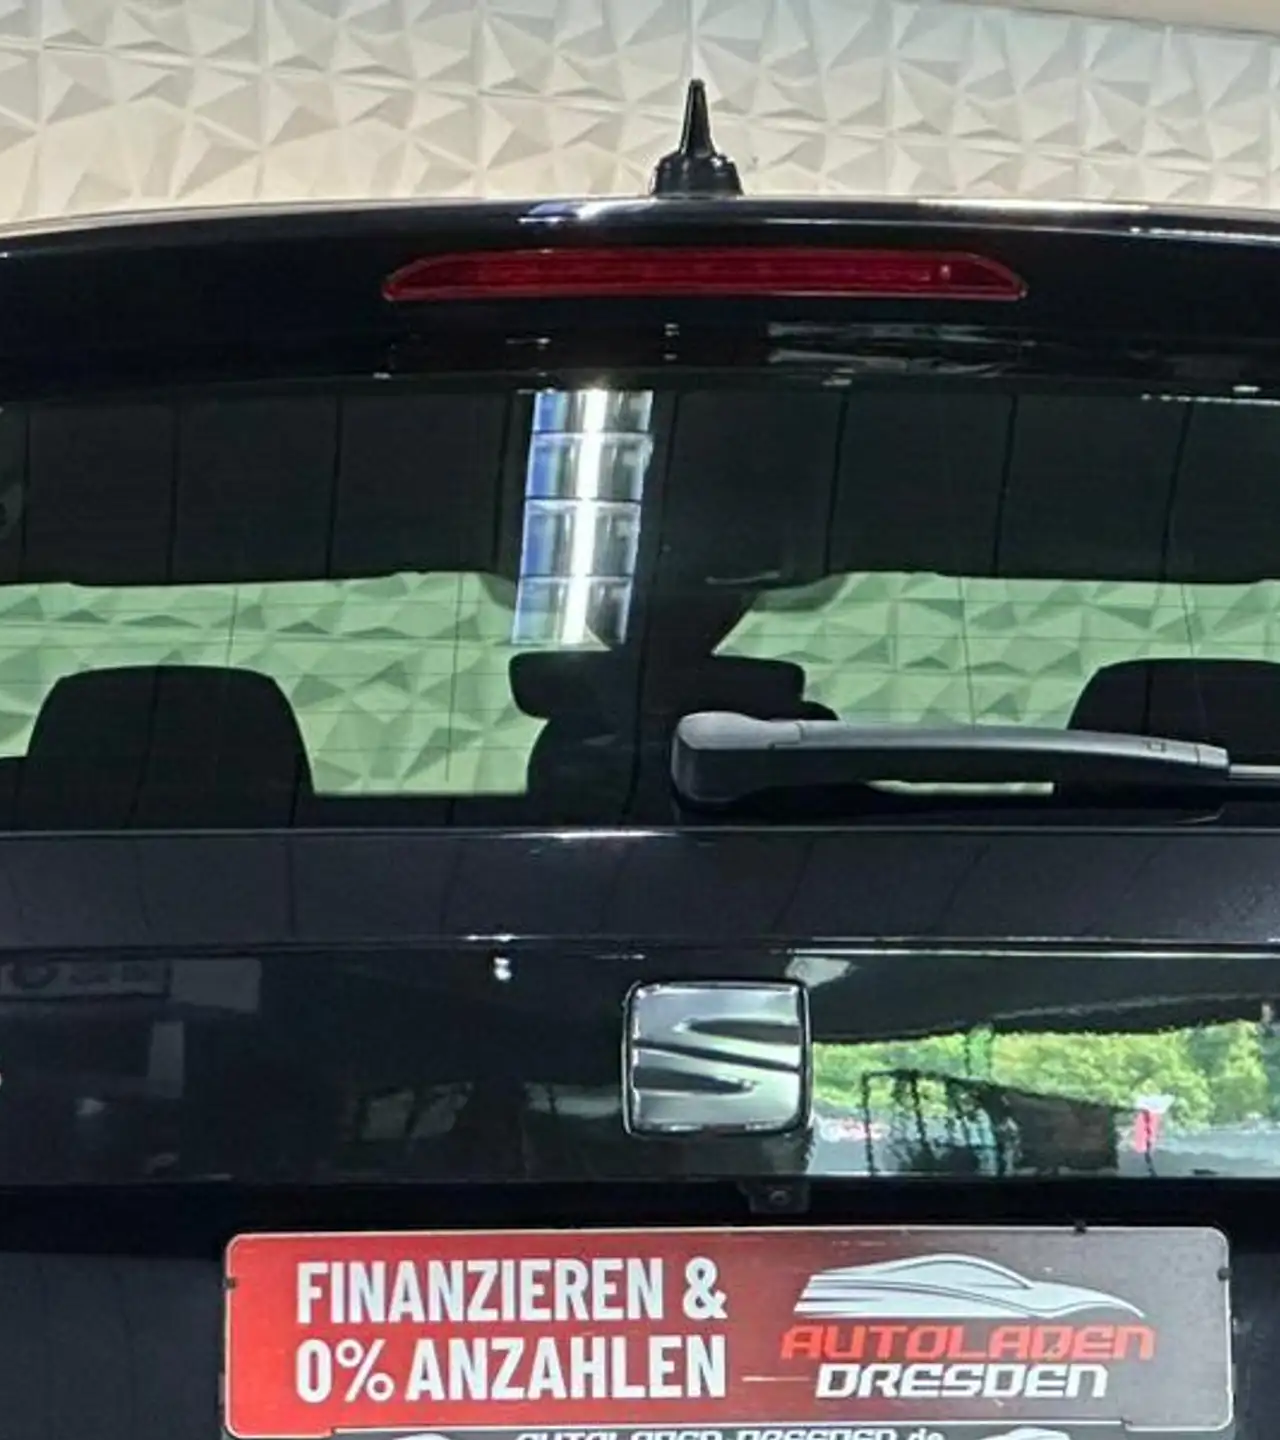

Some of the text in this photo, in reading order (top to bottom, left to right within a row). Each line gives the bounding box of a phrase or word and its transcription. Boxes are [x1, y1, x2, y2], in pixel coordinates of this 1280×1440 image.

[297, 1257, 728, 1324] FINANZIEREN &
[781, 1324, 1155, 1361] AUTOLADEN
[296, 1335, 726, 1404] 0% ANZAHLEN
[817, 1363, 1107, 1399] DRESDEN
